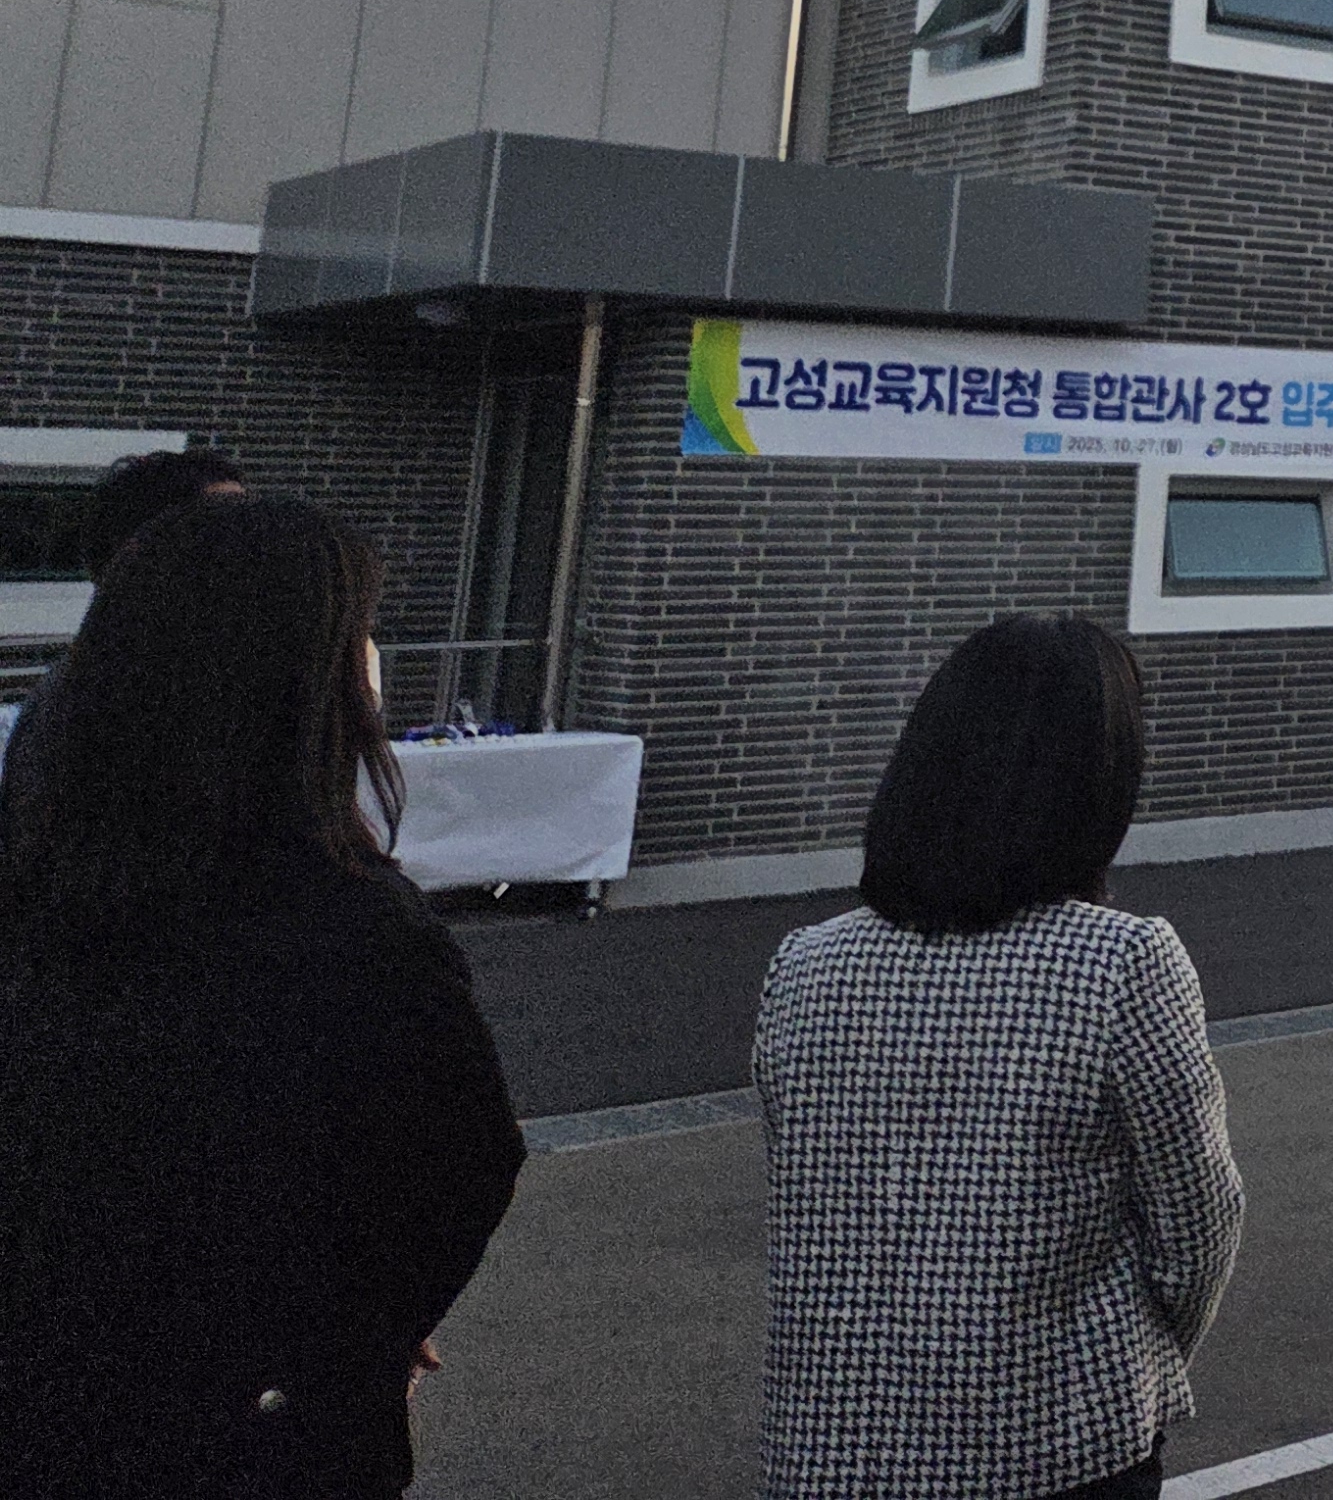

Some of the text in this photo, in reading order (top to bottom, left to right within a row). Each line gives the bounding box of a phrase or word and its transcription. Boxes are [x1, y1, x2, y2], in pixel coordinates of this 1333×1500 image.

[735, 357, 1043, 418] 고성교육지원청
[1052, 370, 1207, 424] 통합관사
[1213, 378, 1273, 424] 2호
